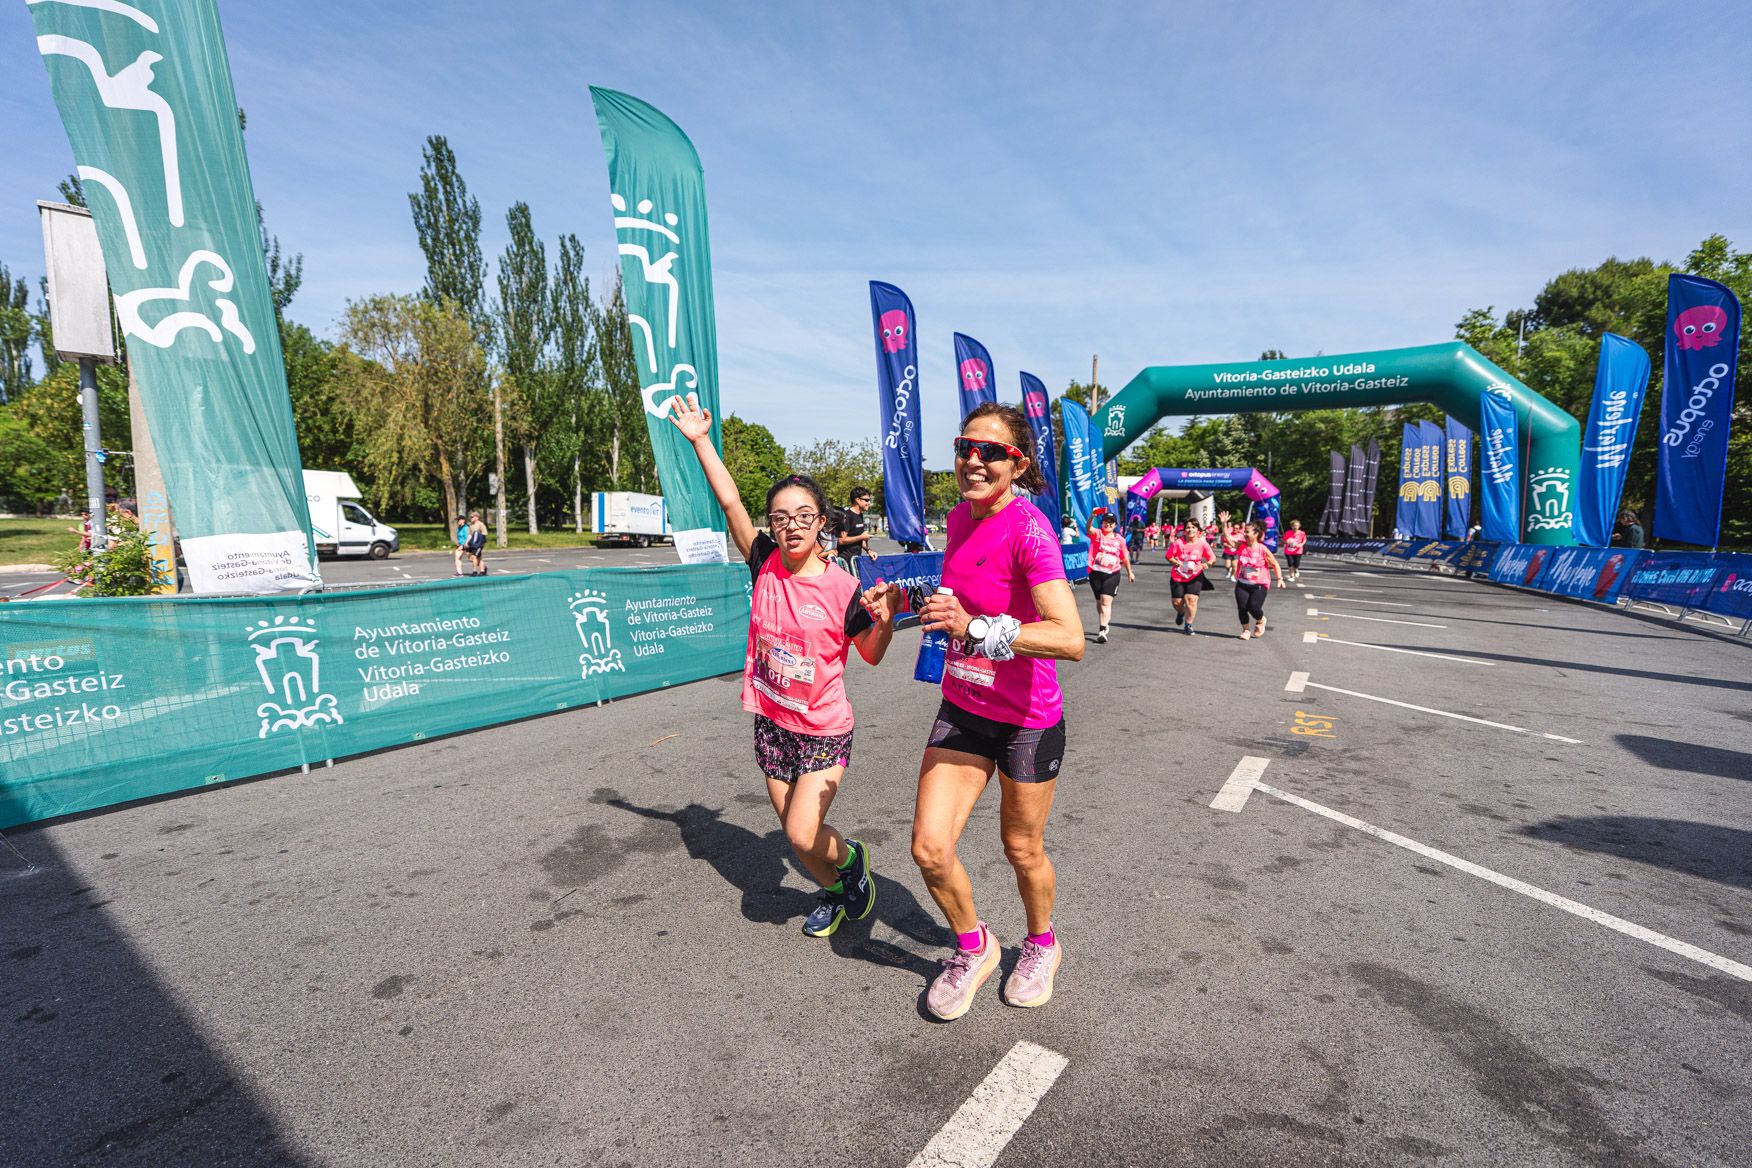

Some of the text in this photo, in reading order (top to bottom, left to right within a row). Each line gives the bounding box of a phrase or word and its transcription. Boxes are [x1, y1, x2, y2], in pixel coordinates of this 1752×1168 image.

[1213, 360, 1376, 384] Vitoria-Gasteizko Udala
[1184, 374, 1409, 401] Ayuntamiento de Vitoria-Gasteiz
[624, 593, 697, 613] Ayuntamiento
[627, 605, 713, 625] de Vitoria-Gasteiz
[353, 615, 481, 642] Ayuntamiento
[629, 621, 714, 643] Vitoria-Gasteizko
[354, 628, 511, 660] de Vitoria-Gasteiz
[633, 642, 665, 657] Udala
[358, 650, 511, 684] Vitoria-Gasteizko
[363, 680, 420, 703] Udala
